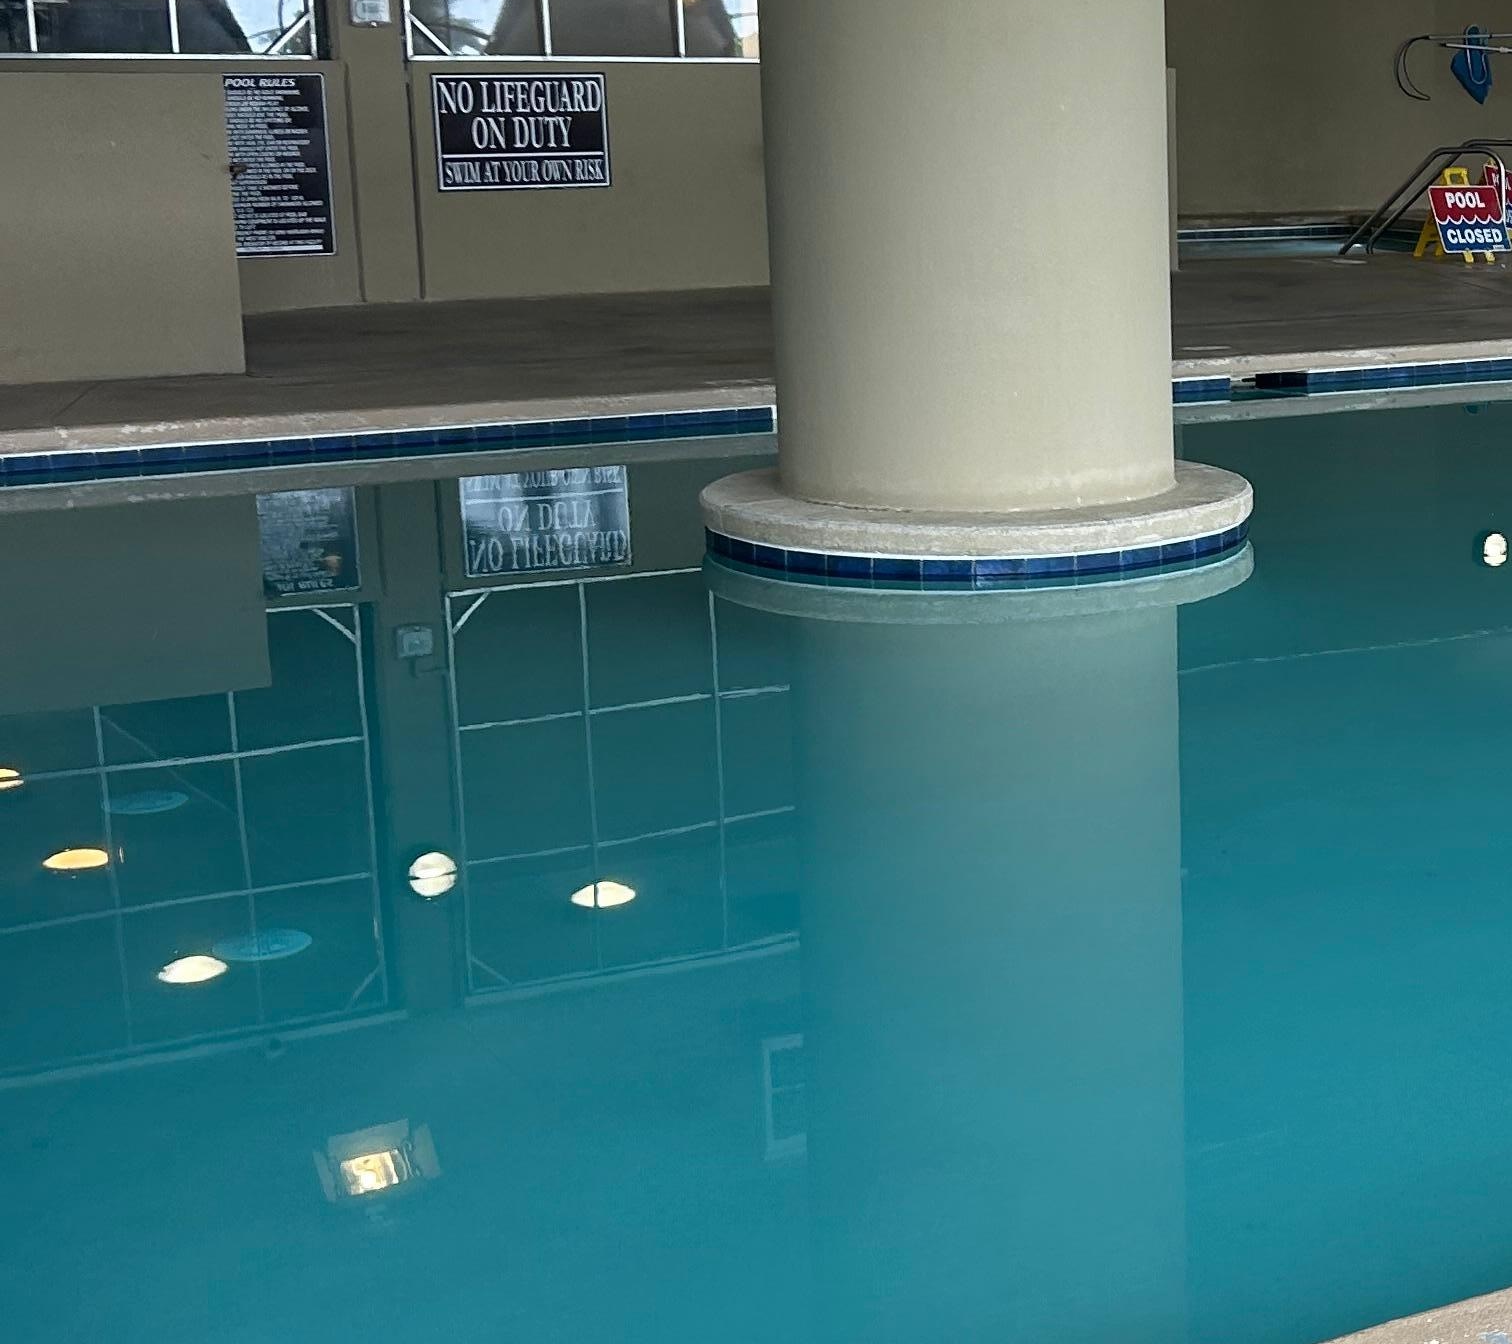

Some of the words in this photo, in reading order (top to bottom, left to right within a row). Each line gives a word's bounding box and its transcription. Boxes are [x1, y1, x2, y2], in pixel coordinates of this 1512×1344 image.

[224, 78, 256, 87] POOL
[259, 78, 295, 87] RULES
[437, 81, 474, 114] NO
[479, 80, 602, 113] LIFEGUARD
[471, 116, 507, 149] ON
[512, 116, 573, 148] DUTY
[445, 161, 481, 184] SWIM
[483, 161, 500, 183] AT
[500, 160, 540, 182] YOUR
[542, 159, 573, 181] OWN
[573, 159, 604, 180] RISK
[1444, 191, 1486, 208] POOL
[1446, 228, 1503, 244] CLOSED
